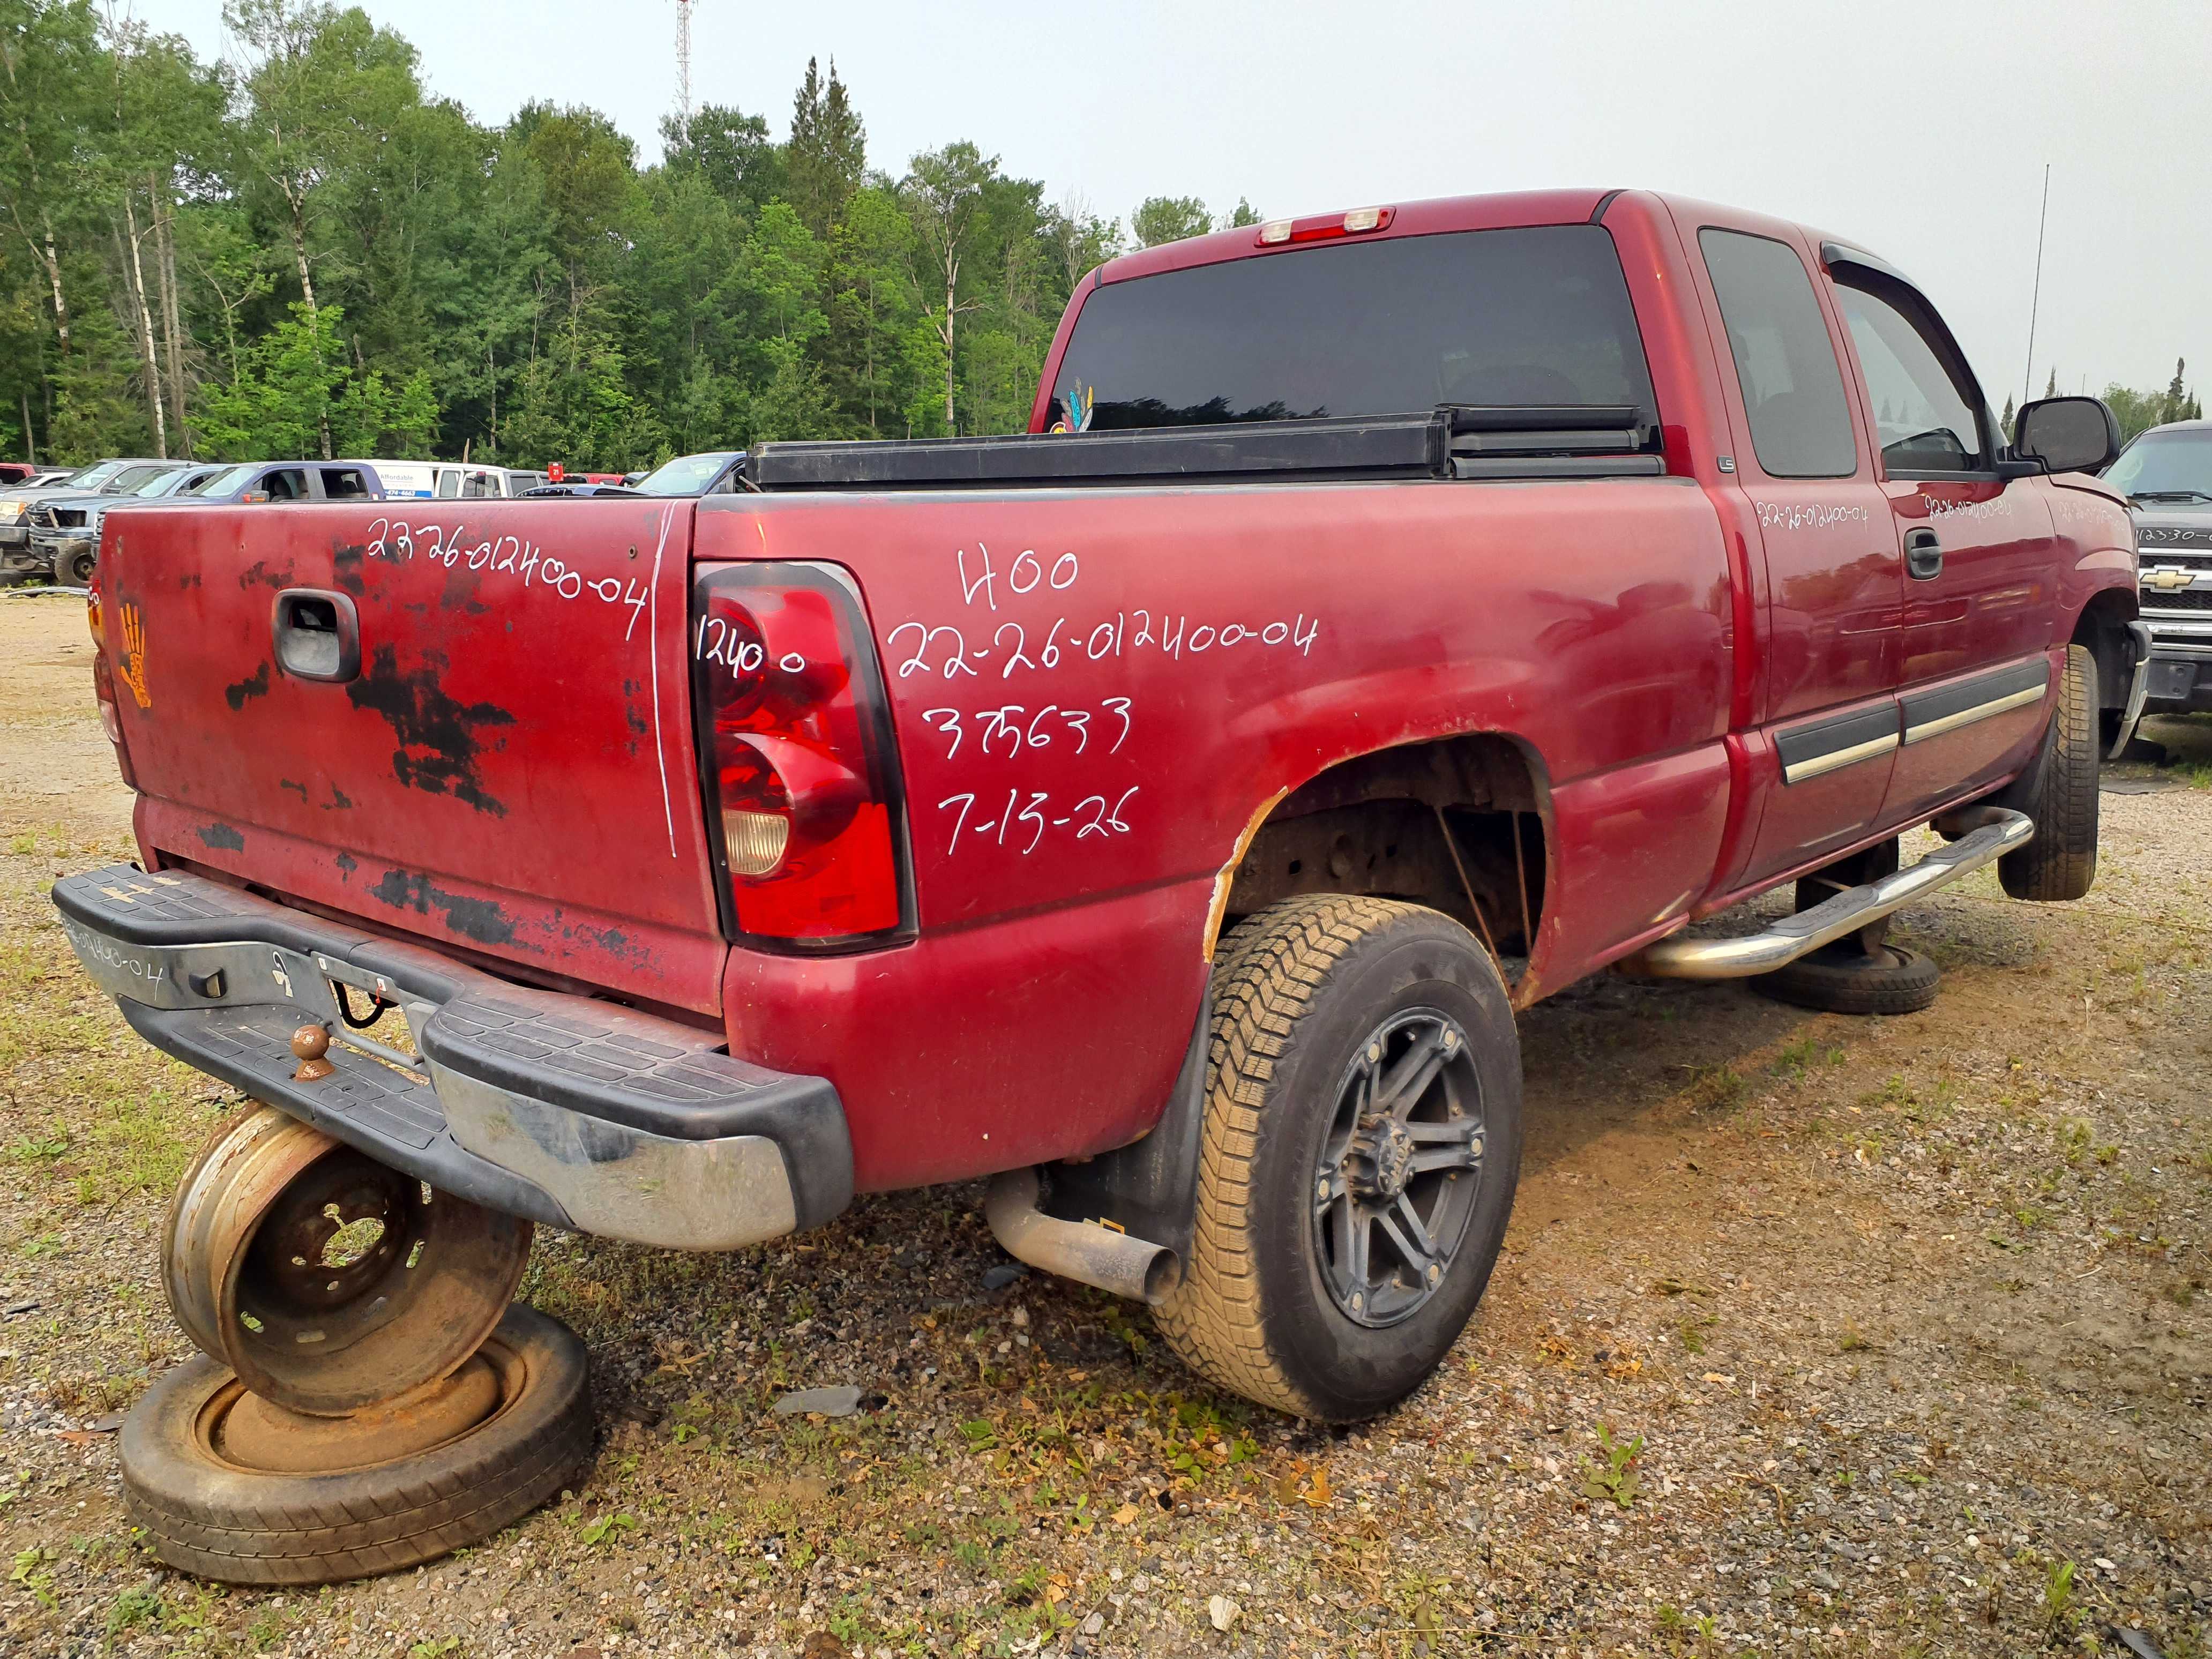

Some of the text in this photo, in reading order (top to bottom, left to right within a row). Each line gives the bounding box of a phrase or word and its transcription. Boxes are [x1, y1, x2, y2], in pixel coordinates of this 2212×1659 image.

[1720, 460, 1734, 469] LS
[1757, 501, 1869, 533] 22-26-012400-04
[958, 542, 1078, 611] 400
[887, 610, 1318, 679] 22-26-012400-04
